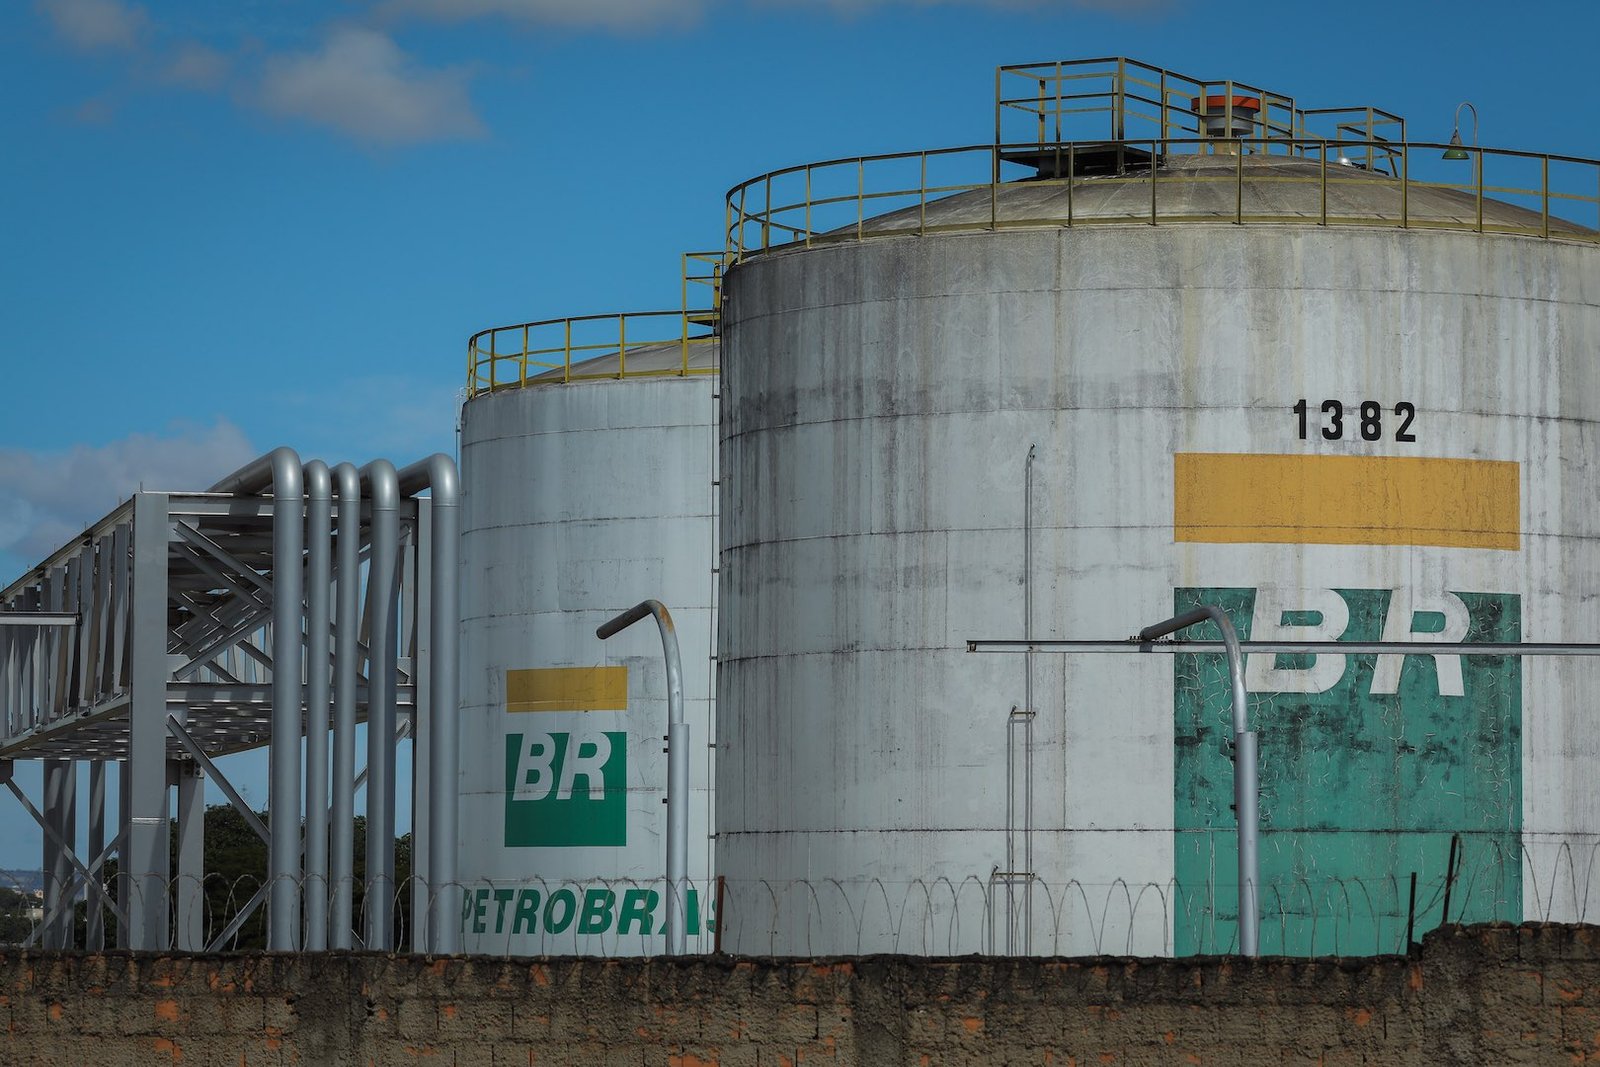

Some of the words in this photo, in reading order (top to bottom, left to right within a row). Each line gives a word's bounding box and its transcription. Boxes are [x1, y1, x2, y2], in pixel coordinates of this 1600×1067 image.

[1293, 399, 1416, 442] 1382
[1246, 588, 1470, 696] BR
[512, 732, 612, 800] BR
